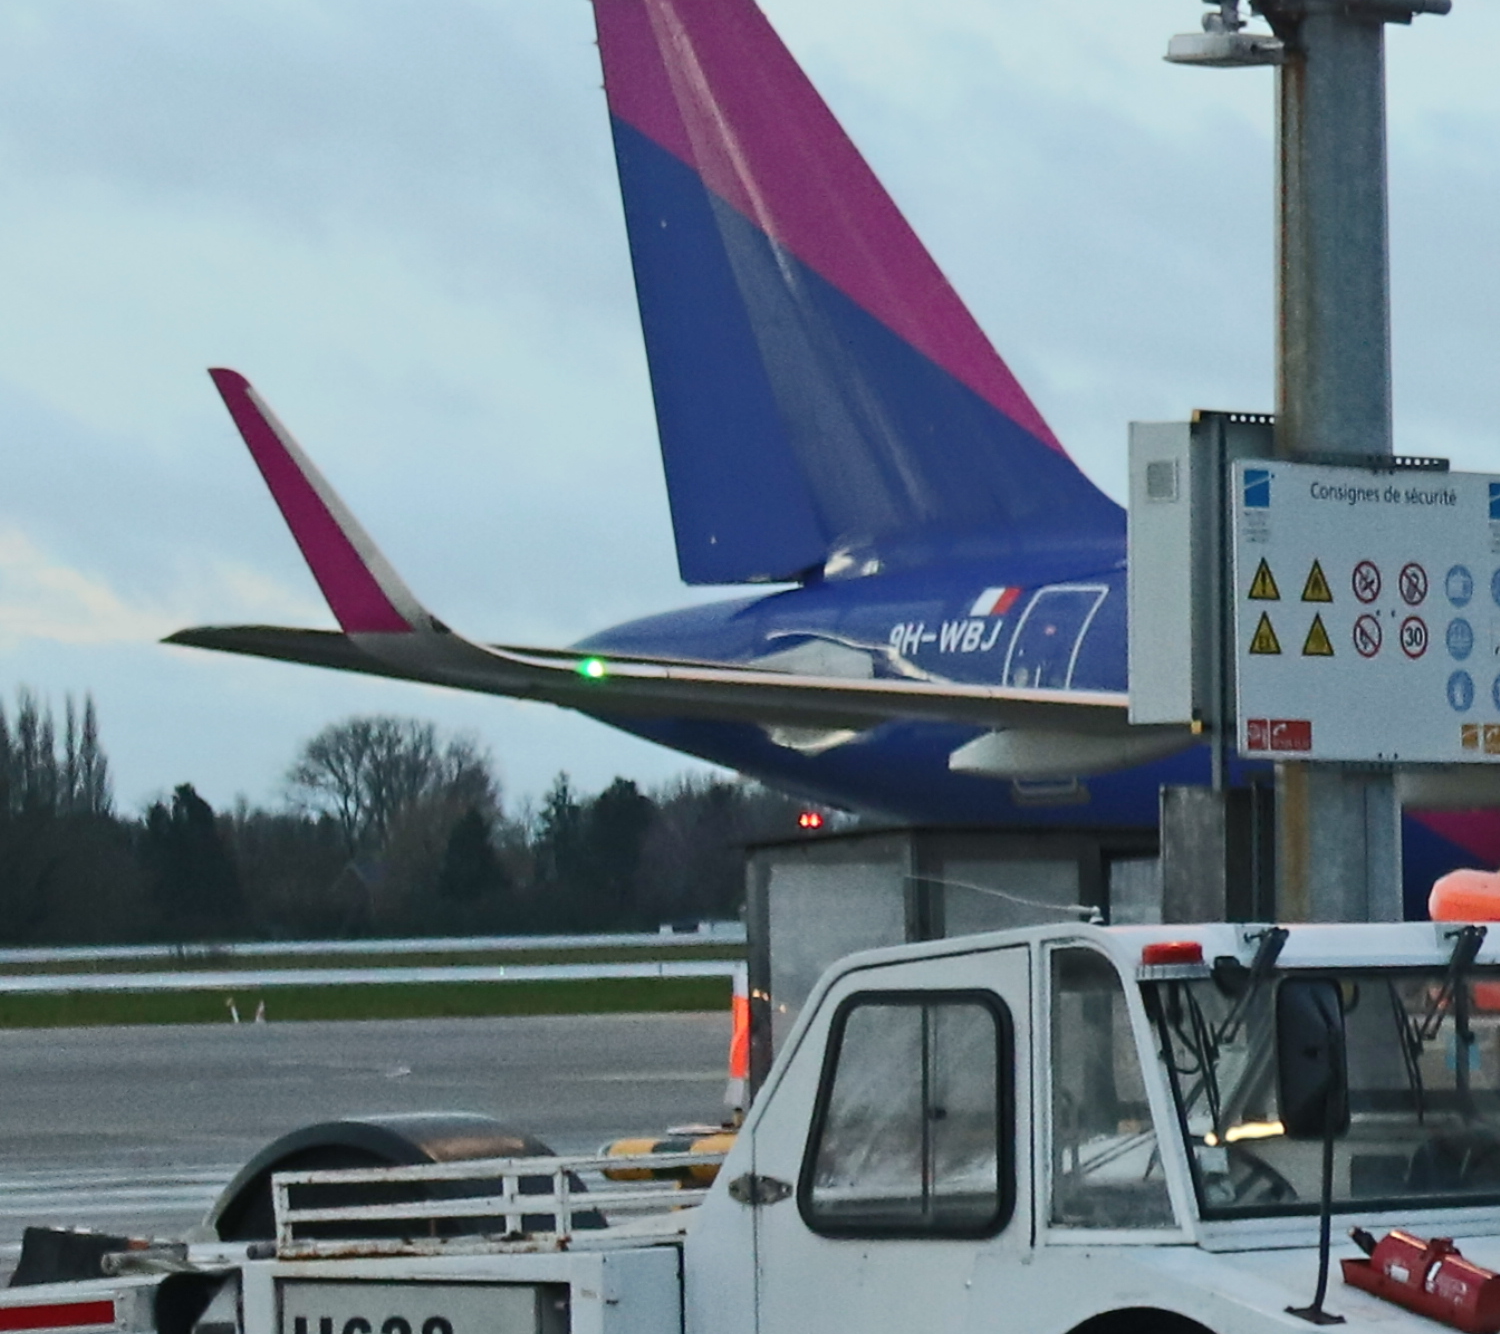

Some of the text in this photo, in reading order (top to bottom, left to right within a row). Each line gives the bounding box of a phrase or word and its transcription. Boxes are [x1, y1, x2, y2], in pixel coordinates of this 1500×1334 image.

[1310, 482, 1457, 506] Consignes de sécurité
[889, 619, 1003, 655] 9H-WBJ
[1405, 627, 1423, 647] 30
